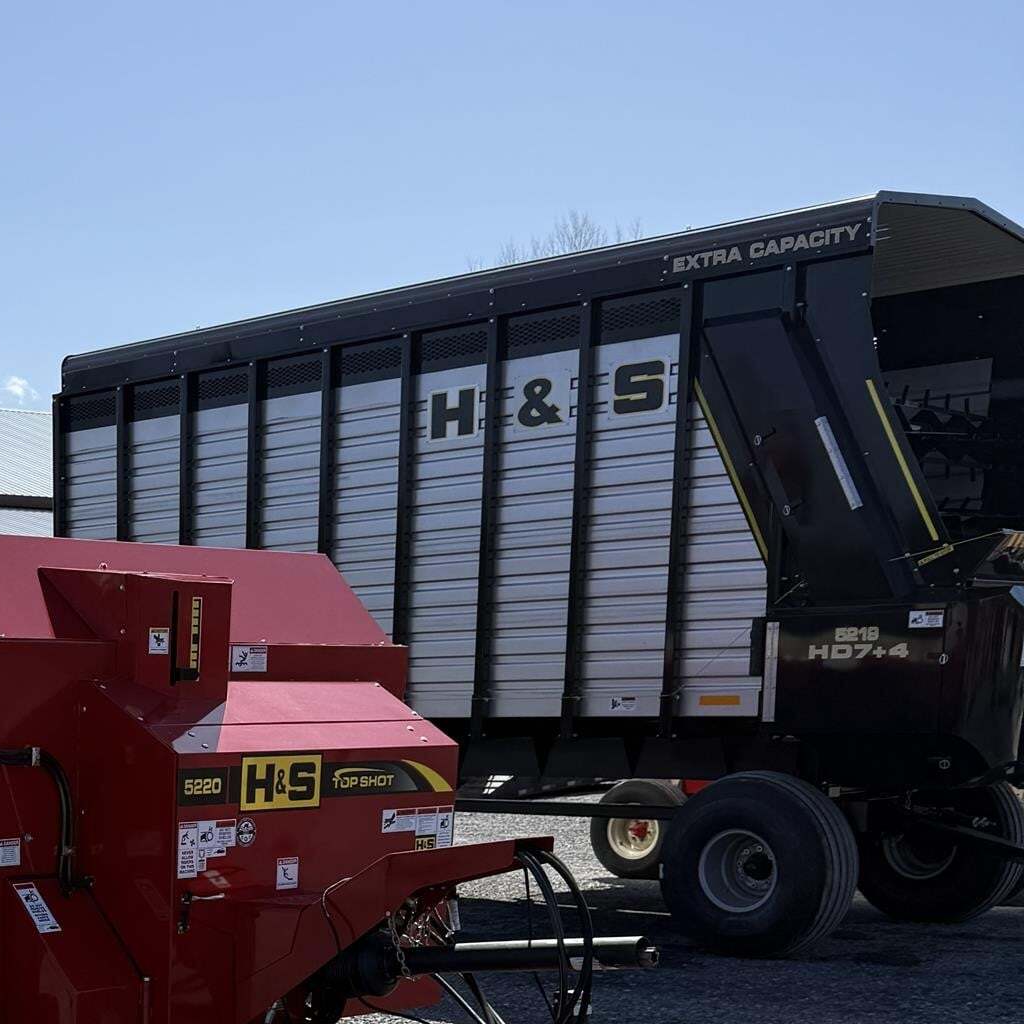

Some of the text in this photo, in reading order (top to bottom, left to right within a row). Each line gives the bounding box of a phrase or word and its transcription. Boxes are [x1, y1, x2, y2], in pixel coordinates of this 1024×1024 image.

[672, 223, 862, 273] EXTRA CAPACITY
[430, 388, 476, 440] H
[613, 360, 665, 414] S
[807, 643, 909, 660] HD7+4
[183, 777, 222, 796] 5220
[244, 761, 317, 805] H&S
